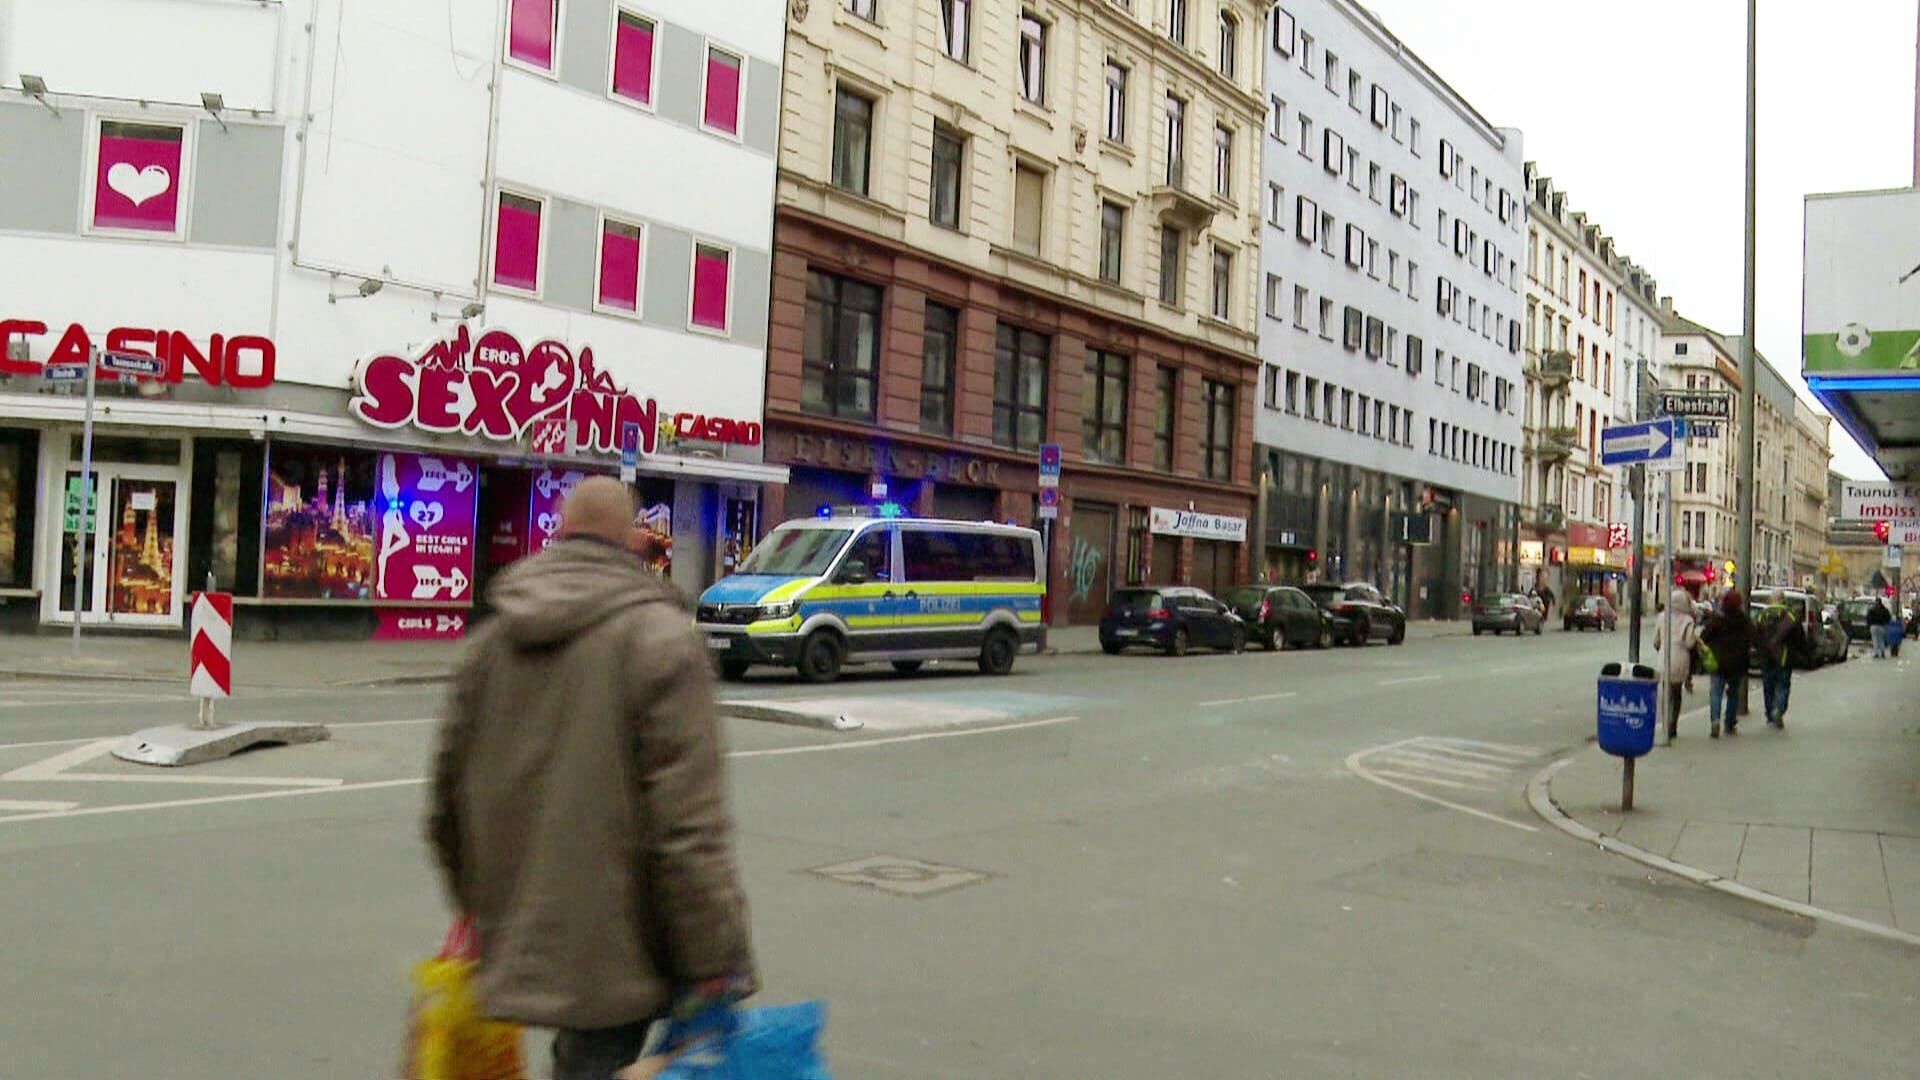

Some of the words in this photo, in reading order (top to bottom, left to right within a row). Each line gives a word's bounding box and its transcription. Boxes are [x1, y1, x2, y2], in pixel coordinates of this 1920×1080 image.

[0, 319, 276, 389] CASINO
[480, 346, 520, 366] EROS
[360, 355, 516, 438] SEX
[1665, 397, 1726, 414] Elbestraße
[674, 412, 761, 446] CASINO
[1847, 486, 1898, 498] Taunus
[418, 511, 436, 522] 27
[1860, 504, 1915, 517] Imbiss
[1173, 511, 1208, 529] Jaffna
[441, 536, 468, 546] GIRLS
[920, 600, 960, 612] POLIZEI
[398, 618, 432, 629] GIRLS
